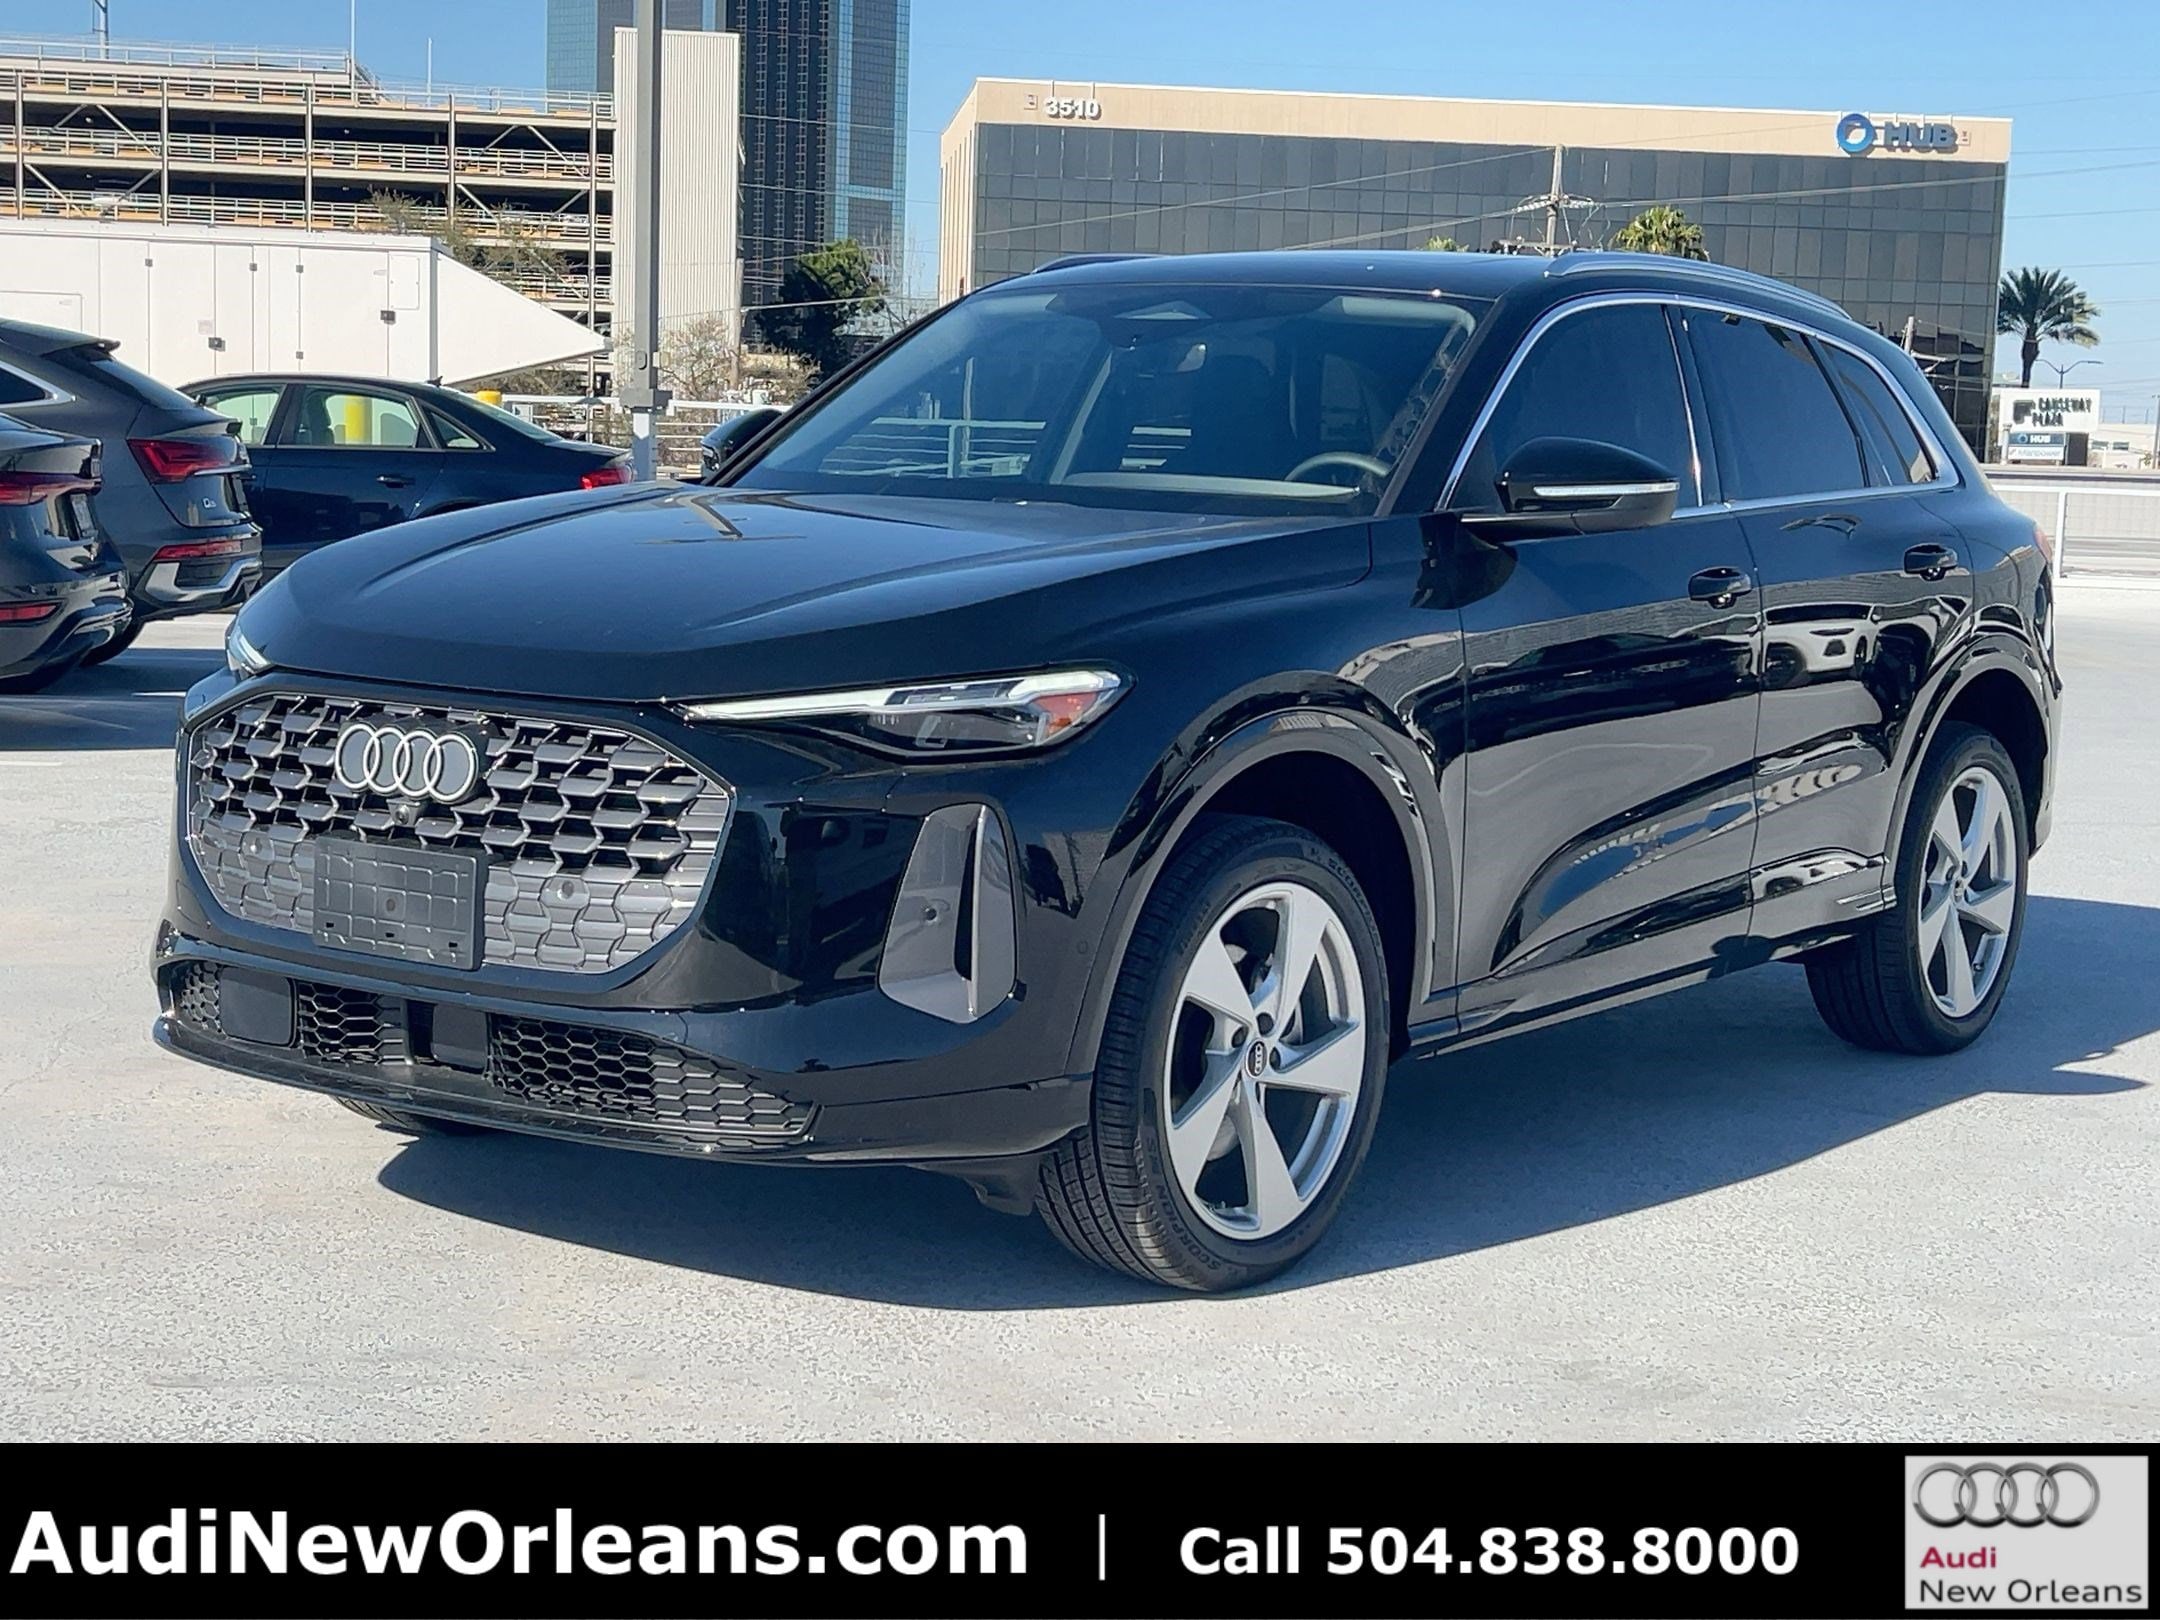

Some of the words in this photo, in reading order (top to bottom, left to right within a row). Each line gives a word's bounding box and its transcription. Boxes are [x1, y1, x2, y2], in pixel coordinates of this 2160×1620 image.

[1044, 97, 1100, 118] 3510
[1884, 121, 1958, 151] HUB
[2032, 411, 2064, 427] PLAZA
[2030, 434, 2051, 444] HUB
